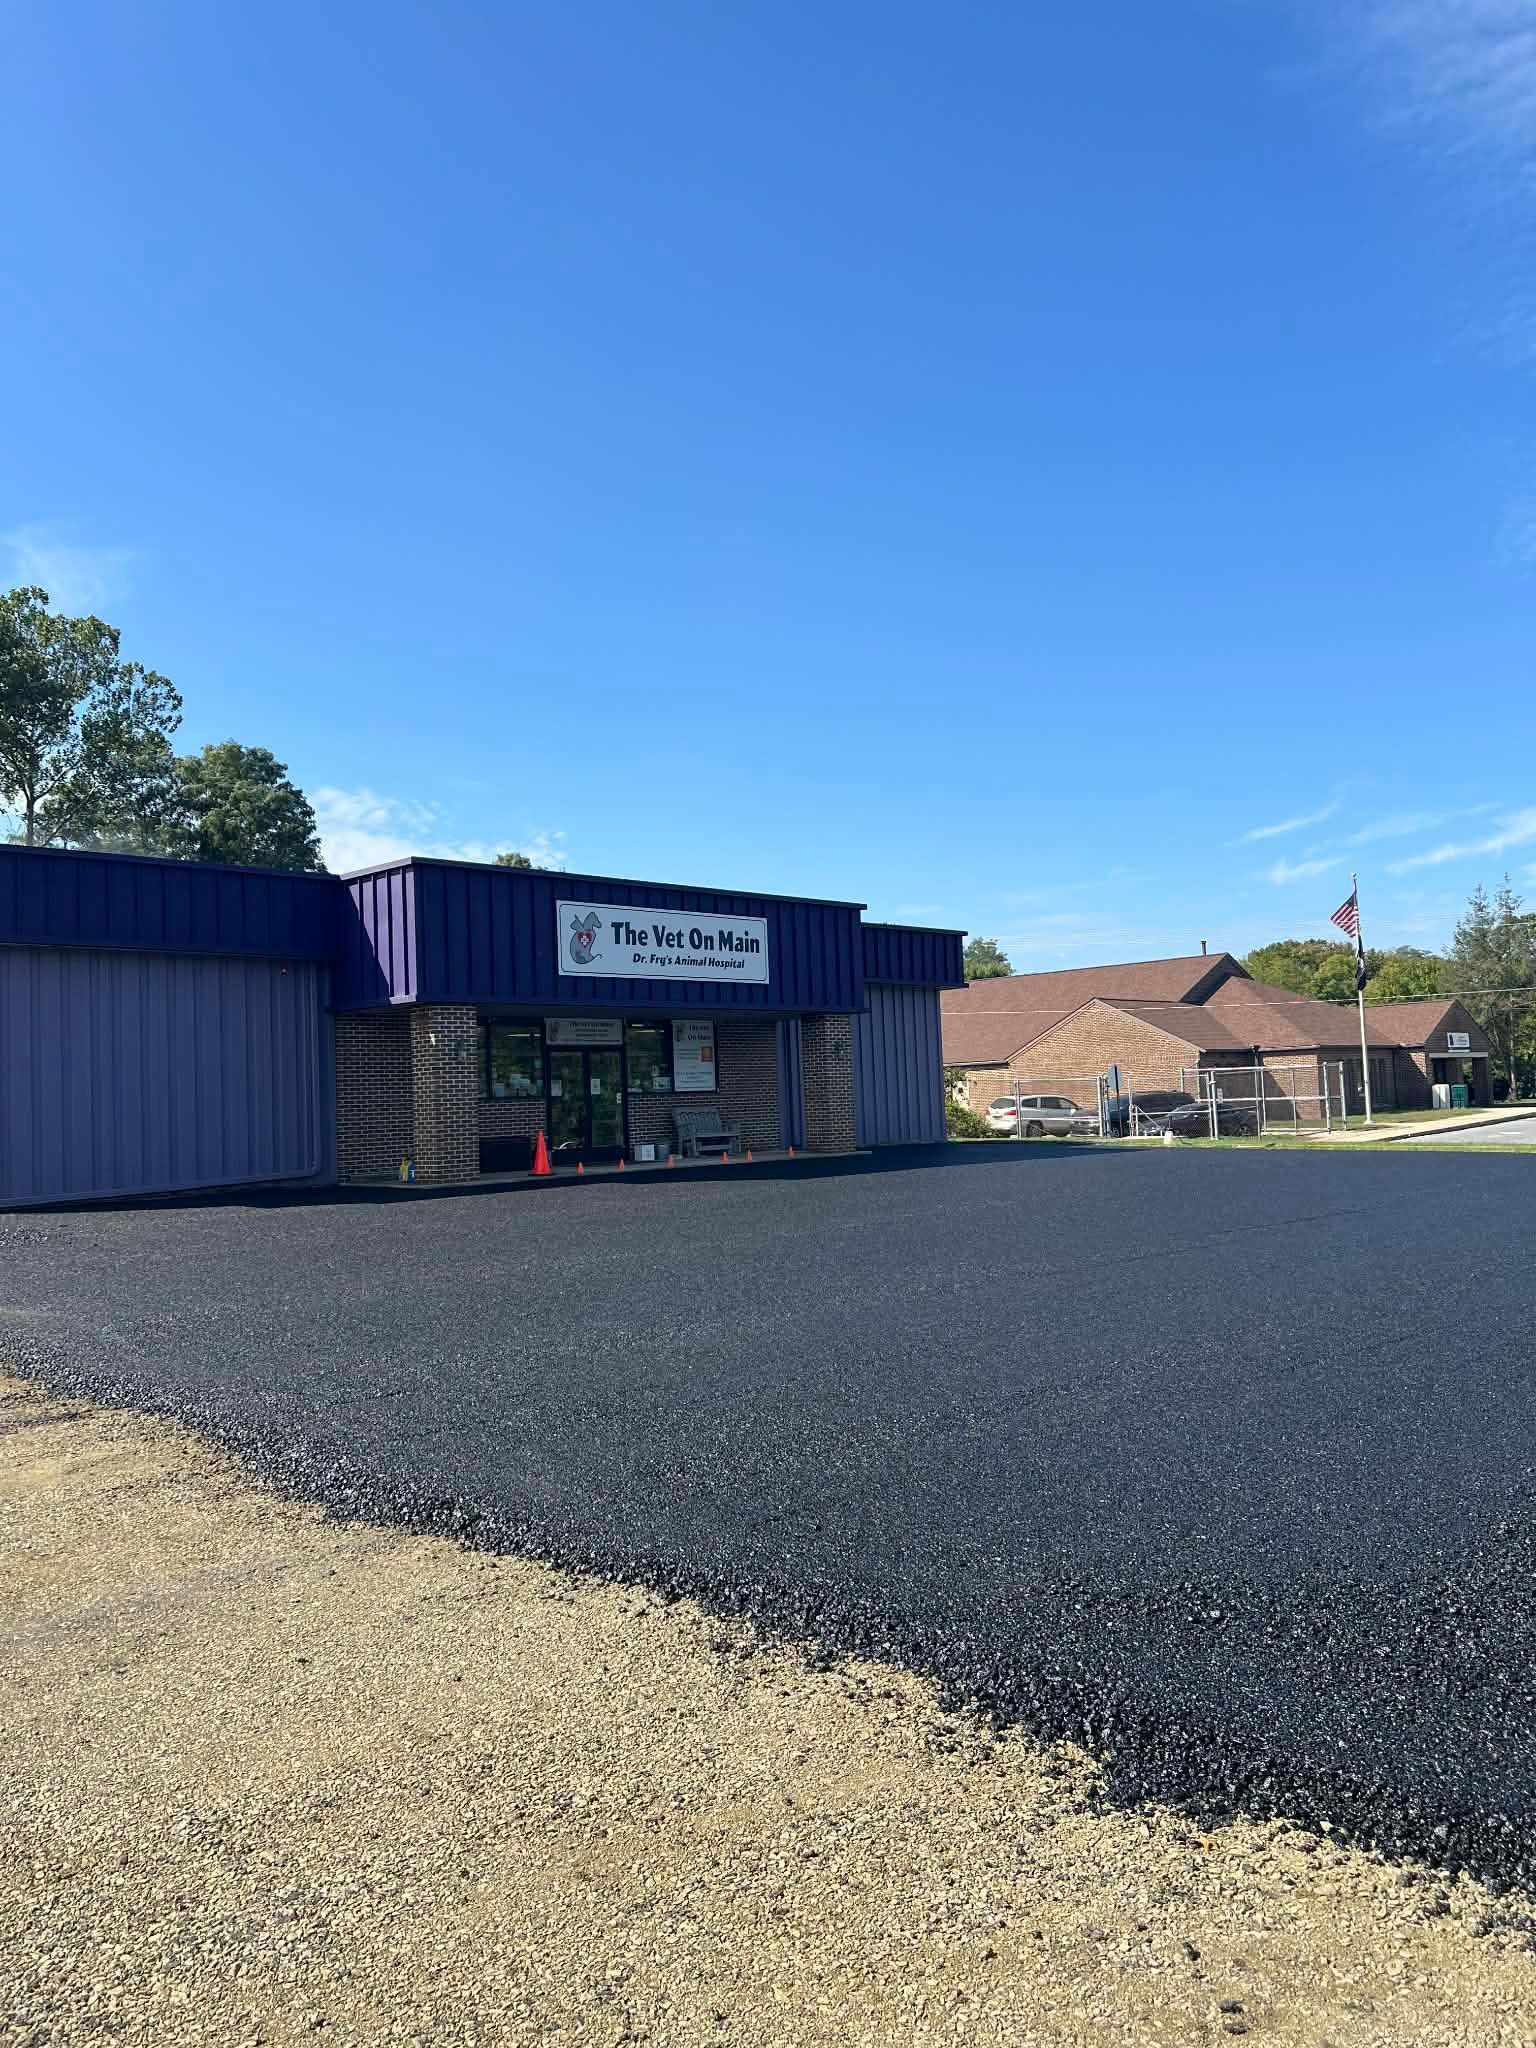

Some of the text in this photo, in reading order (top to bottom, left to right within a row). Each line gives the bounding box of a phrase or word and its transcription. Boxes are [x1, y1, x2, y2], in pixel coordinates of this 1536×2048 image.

[611, 921, 760, 954] The Vet On Main
[632, 953, 745, 969] Dr. Fry's Animal Hospital
